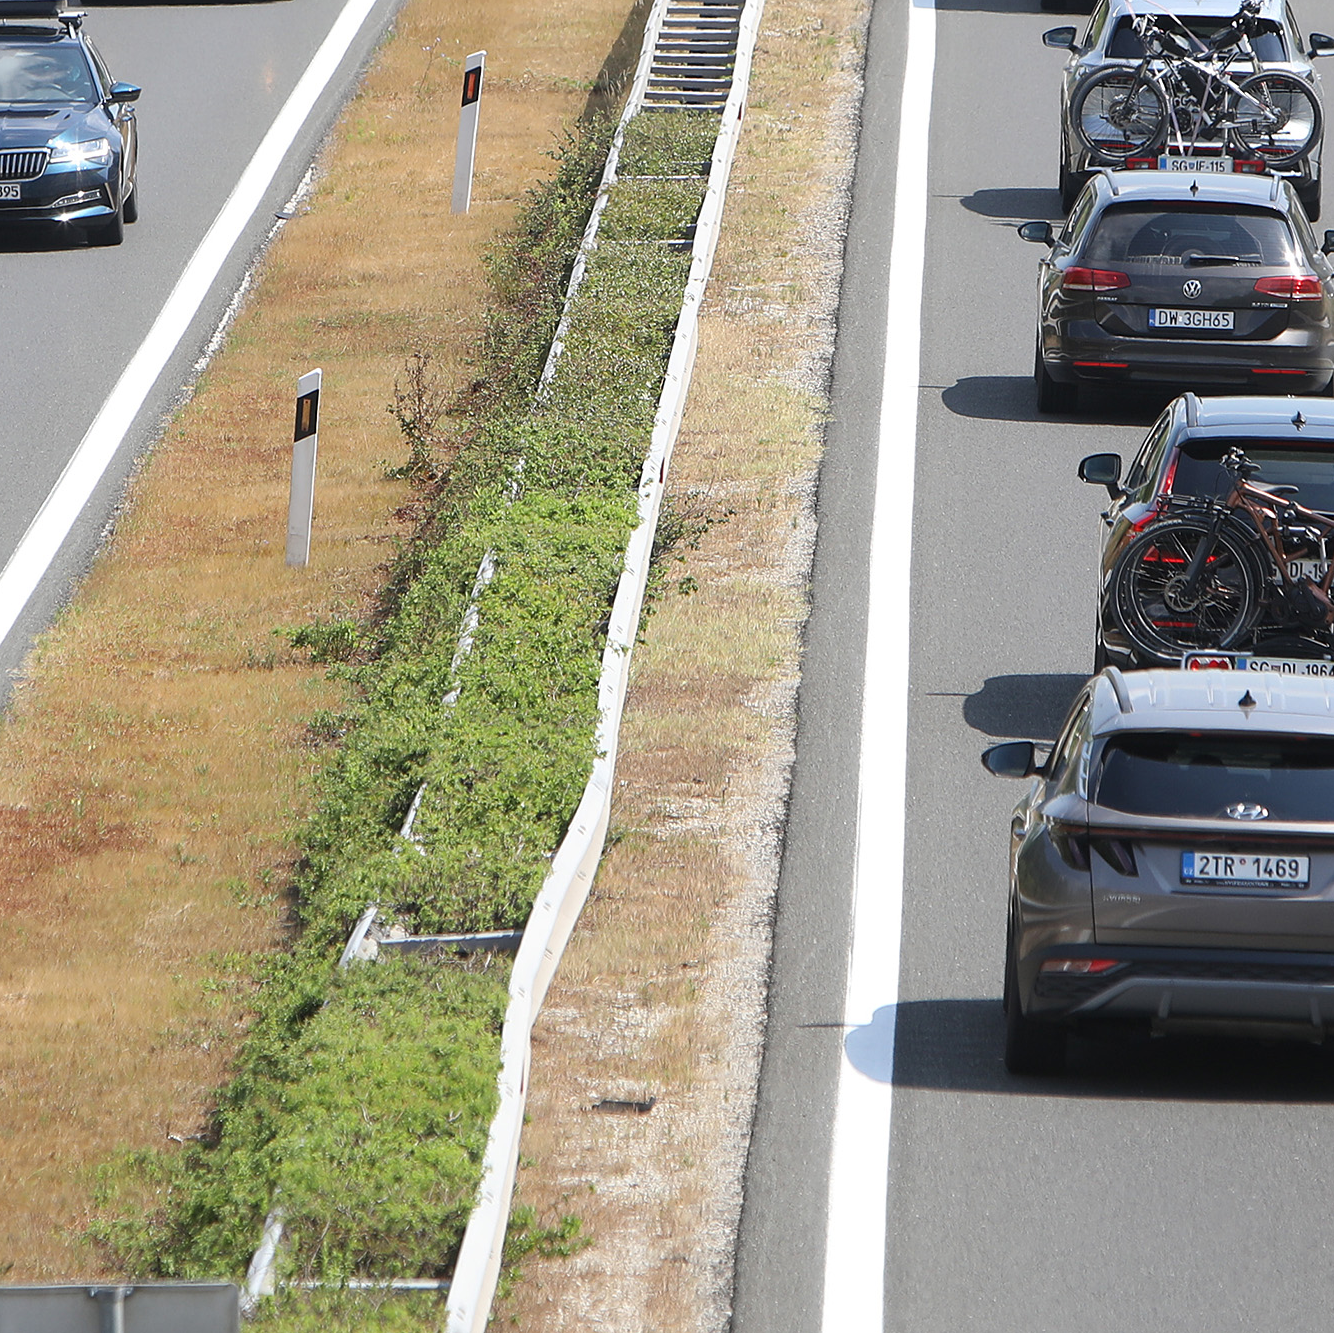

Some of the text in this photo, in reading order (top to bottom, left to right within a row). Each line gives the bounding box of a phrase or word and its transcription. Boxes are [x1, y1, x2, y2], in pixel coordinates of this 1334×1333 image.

[1158, 310, 1230, 327] DW 3GH65
[1199, 856, 1299, 879] 2TR 1469
